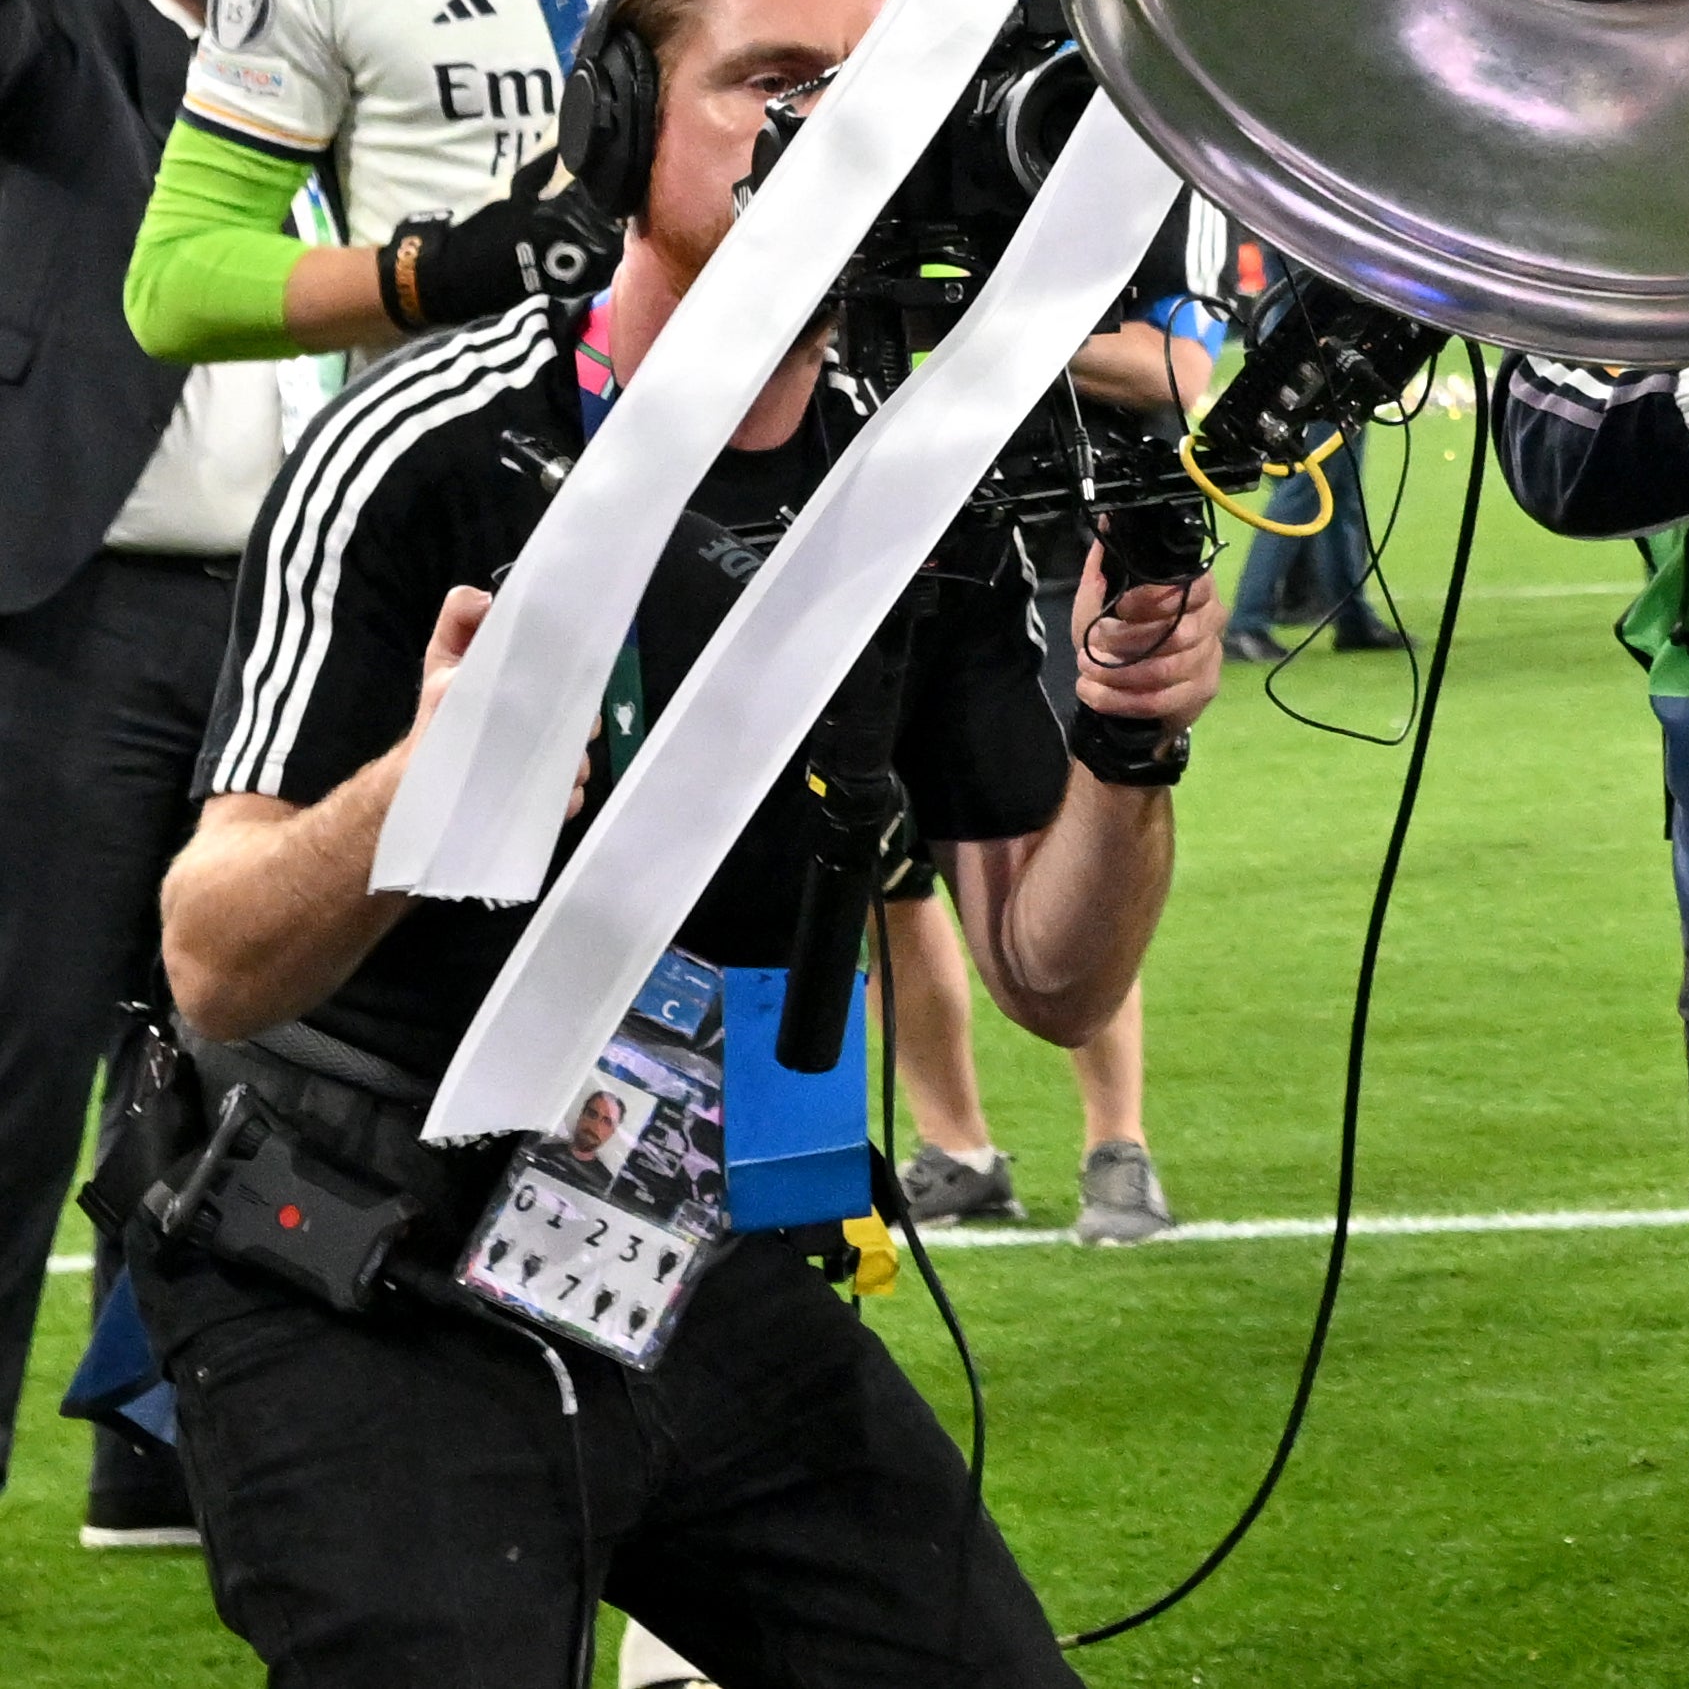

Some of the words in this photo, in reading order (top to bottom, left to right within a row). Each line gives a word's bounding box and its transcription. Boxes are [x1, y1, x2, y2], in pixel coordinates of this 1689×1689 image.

[661, 999, 680, 1020] C
[513, 1183, 536, 1213] 0
[546, 1201, 563, 1229] 1
[584, 1219, 608, 1248] 2
[618, 1235, 640, 1263] 3
[557, 1275, 581, 1301] 7
